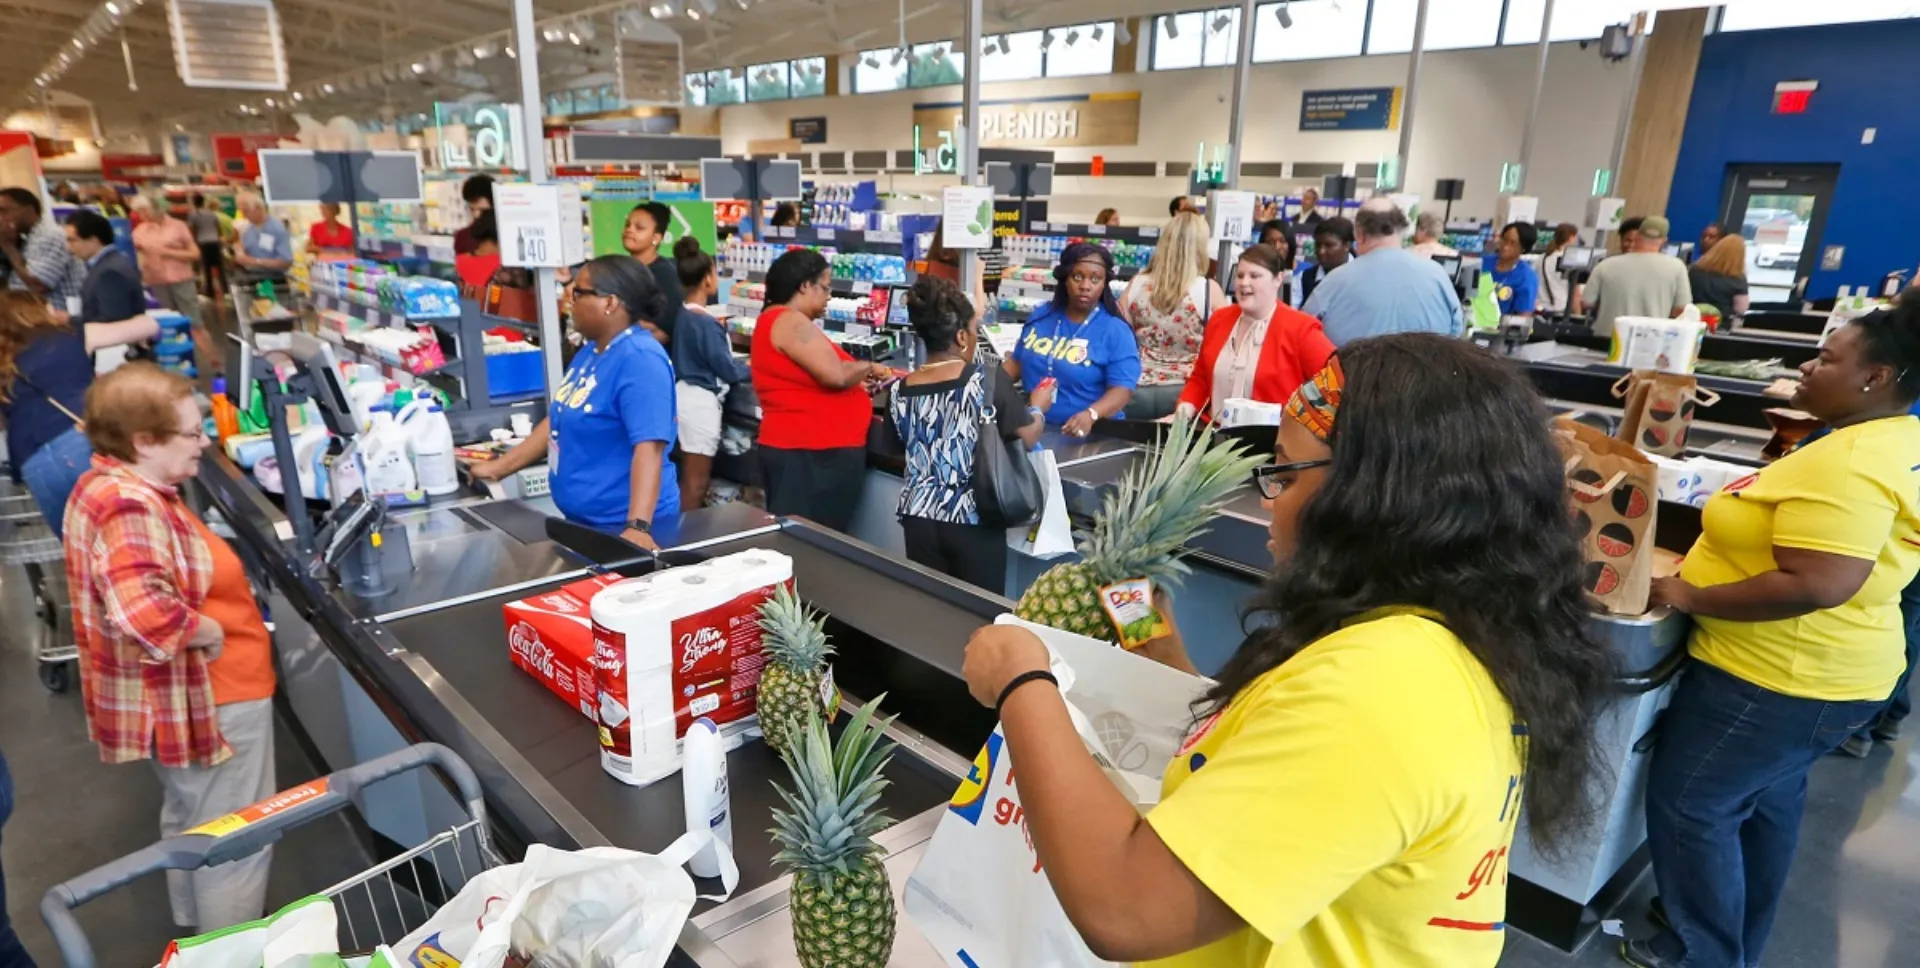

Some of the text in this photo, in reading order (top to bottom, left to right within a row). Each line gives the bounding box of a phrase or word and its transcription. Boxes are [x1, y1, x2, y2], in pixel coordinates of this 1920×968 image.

[1109, 586, 1144, 606] Dole
[679, 626, 723, 651] Ultra
[679, 638, 729, 673] Strong
